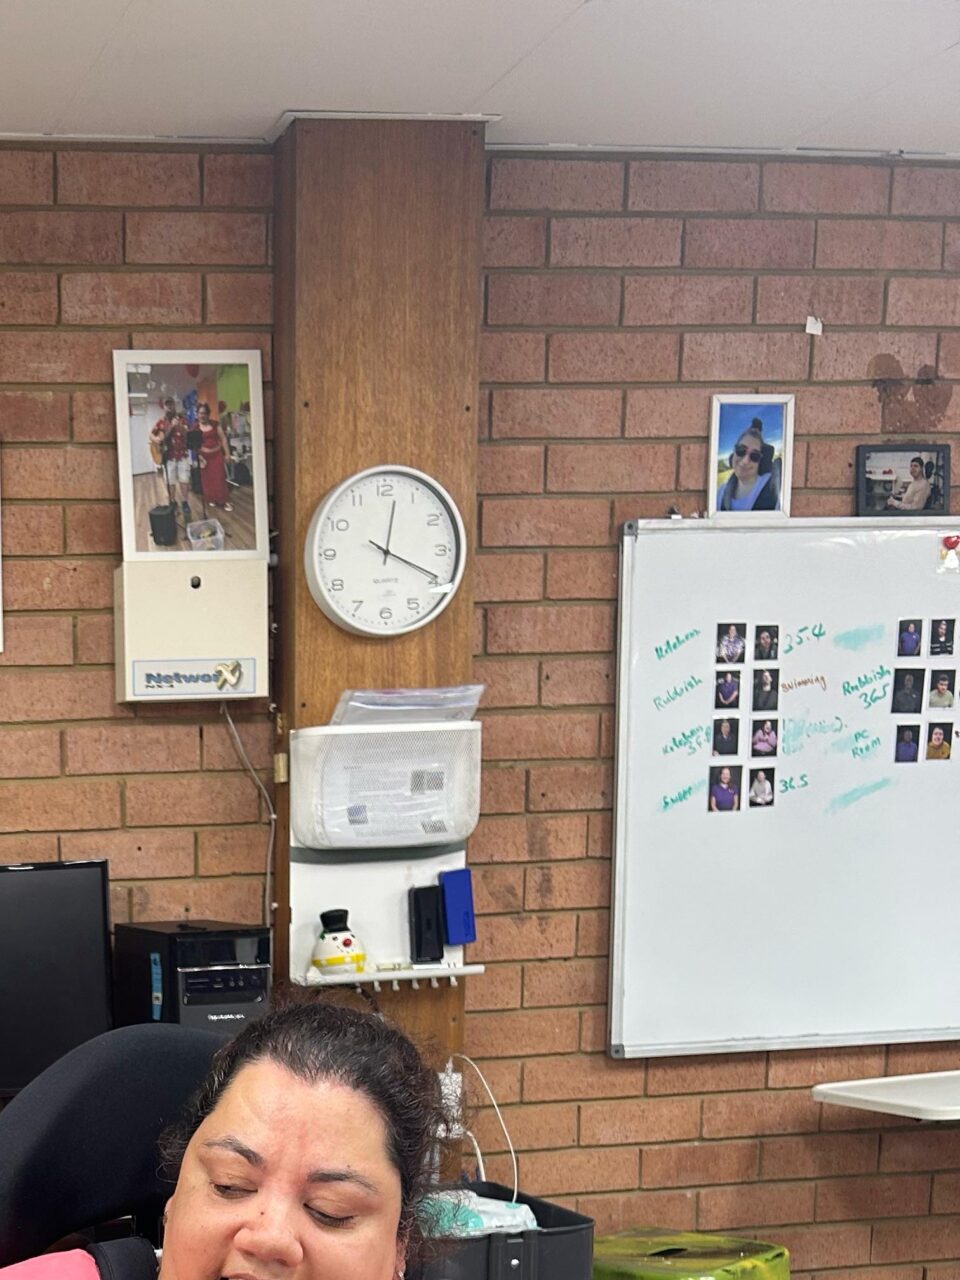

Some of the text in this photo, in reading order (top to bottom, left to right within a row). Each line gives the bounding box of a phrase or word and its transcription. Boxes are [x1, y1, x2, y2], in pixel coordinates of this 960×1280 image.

[376, 484, 394, 497] 12
[352, 494, 363, 506] 11
[331, 519, 350, 532] 10
[426, 513, 440, 527] 2
[323, 548, 337, 561] 9
[434, 544, 448, 557] 3
[331, 579, 344, 591] 8
[352, 600, 364, 613] 7
[407, 598, 420, 610] 5
[379, 607, 393, 620] 6
